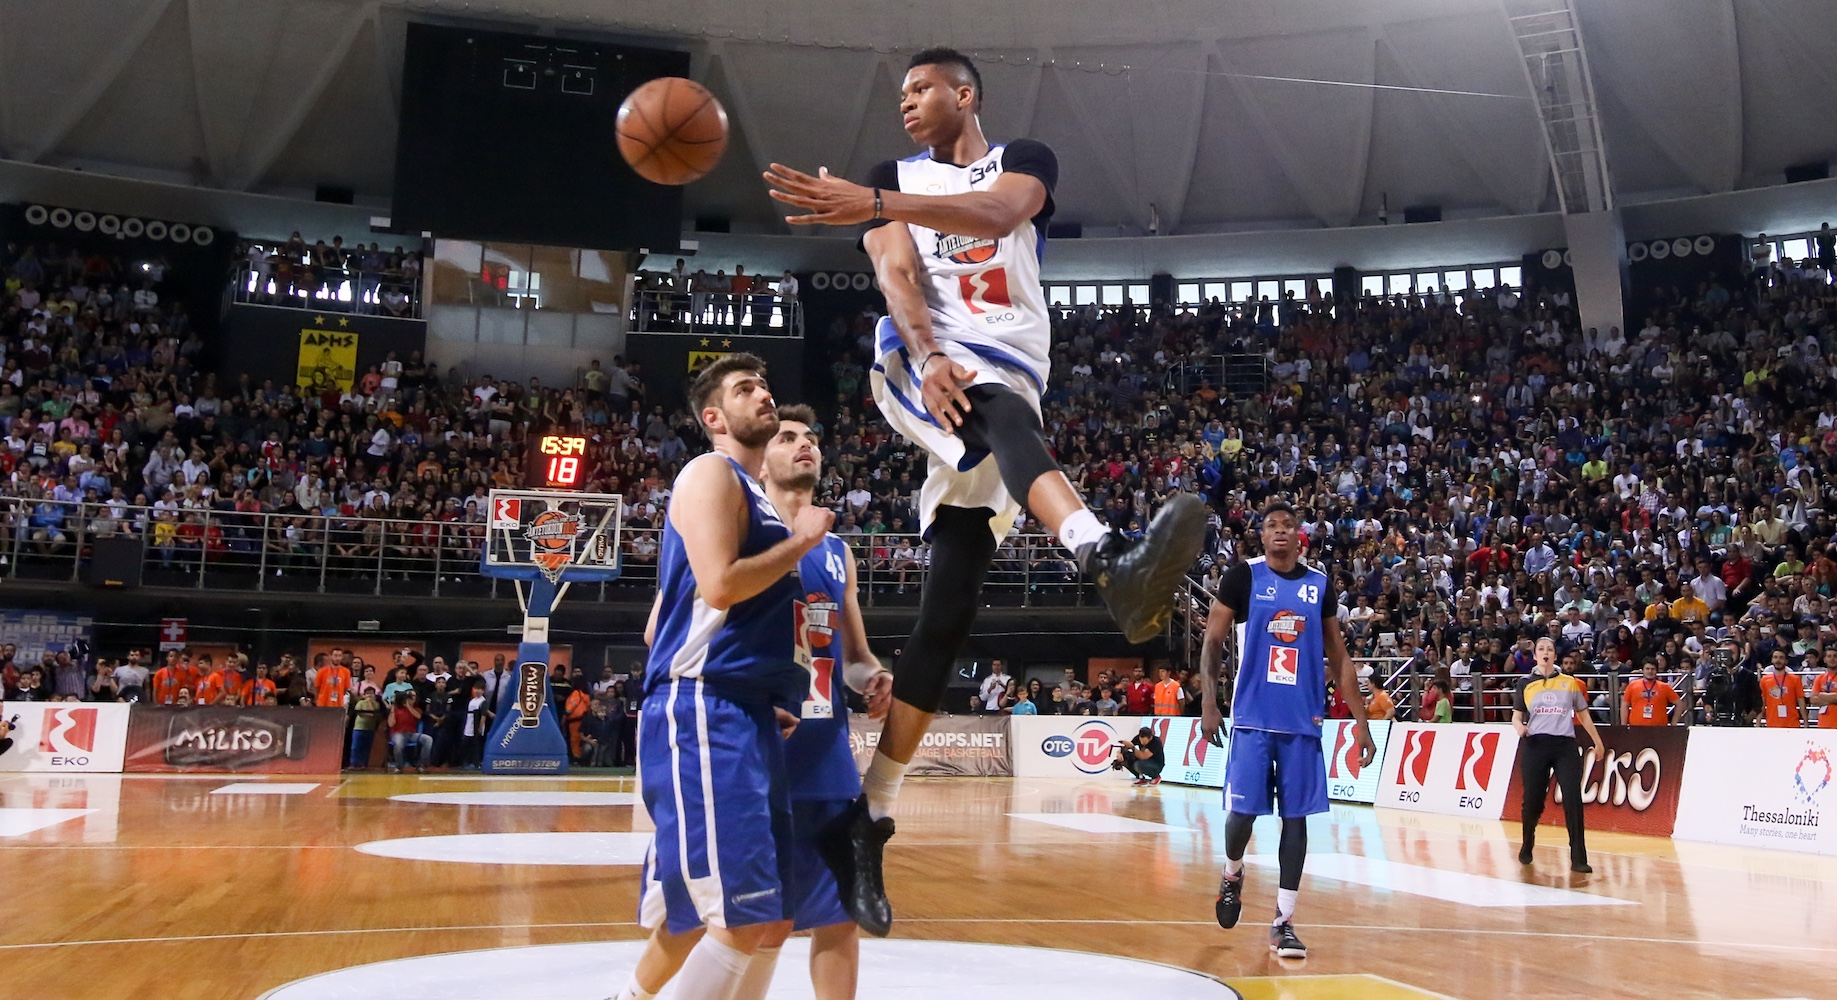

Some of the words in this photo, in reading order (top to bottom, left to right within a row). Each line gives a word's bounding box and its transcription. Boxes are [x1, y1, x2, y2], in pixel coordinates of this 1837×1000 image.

[986, 312, 1015, 324] EKO
[541, 436, 586, 455] 15:39
[548, 457, 578, 483] 18
[825, 551, 846, 584] 43
[1297, 583, 1319, 604] 43
[813, 705, 831, 714] EKO
[501, 715, 523, 749] HYDROP
[944, 748, 1004, 758] BASKETBALL
[1043, 740, 1072, 753] OTE
[1077, 737, 1111, 757] TV
[52, 757, 89, 766] EKO
[1184, 771, 1200, 782] EKO
[1332, 785, 1355, 797] EKO
[1399, 791, 1420, 803] EKO
[1459, 796, 1483, 809] EKO
[1743, 805, 1819, 827] Thessaloniki
[1739, 824, 1759, 837] Many
[1759, 827, 1784, 839] stories,
[1785, 831, 1798, 839] one
[1798, 829, 1817, 841] heart
